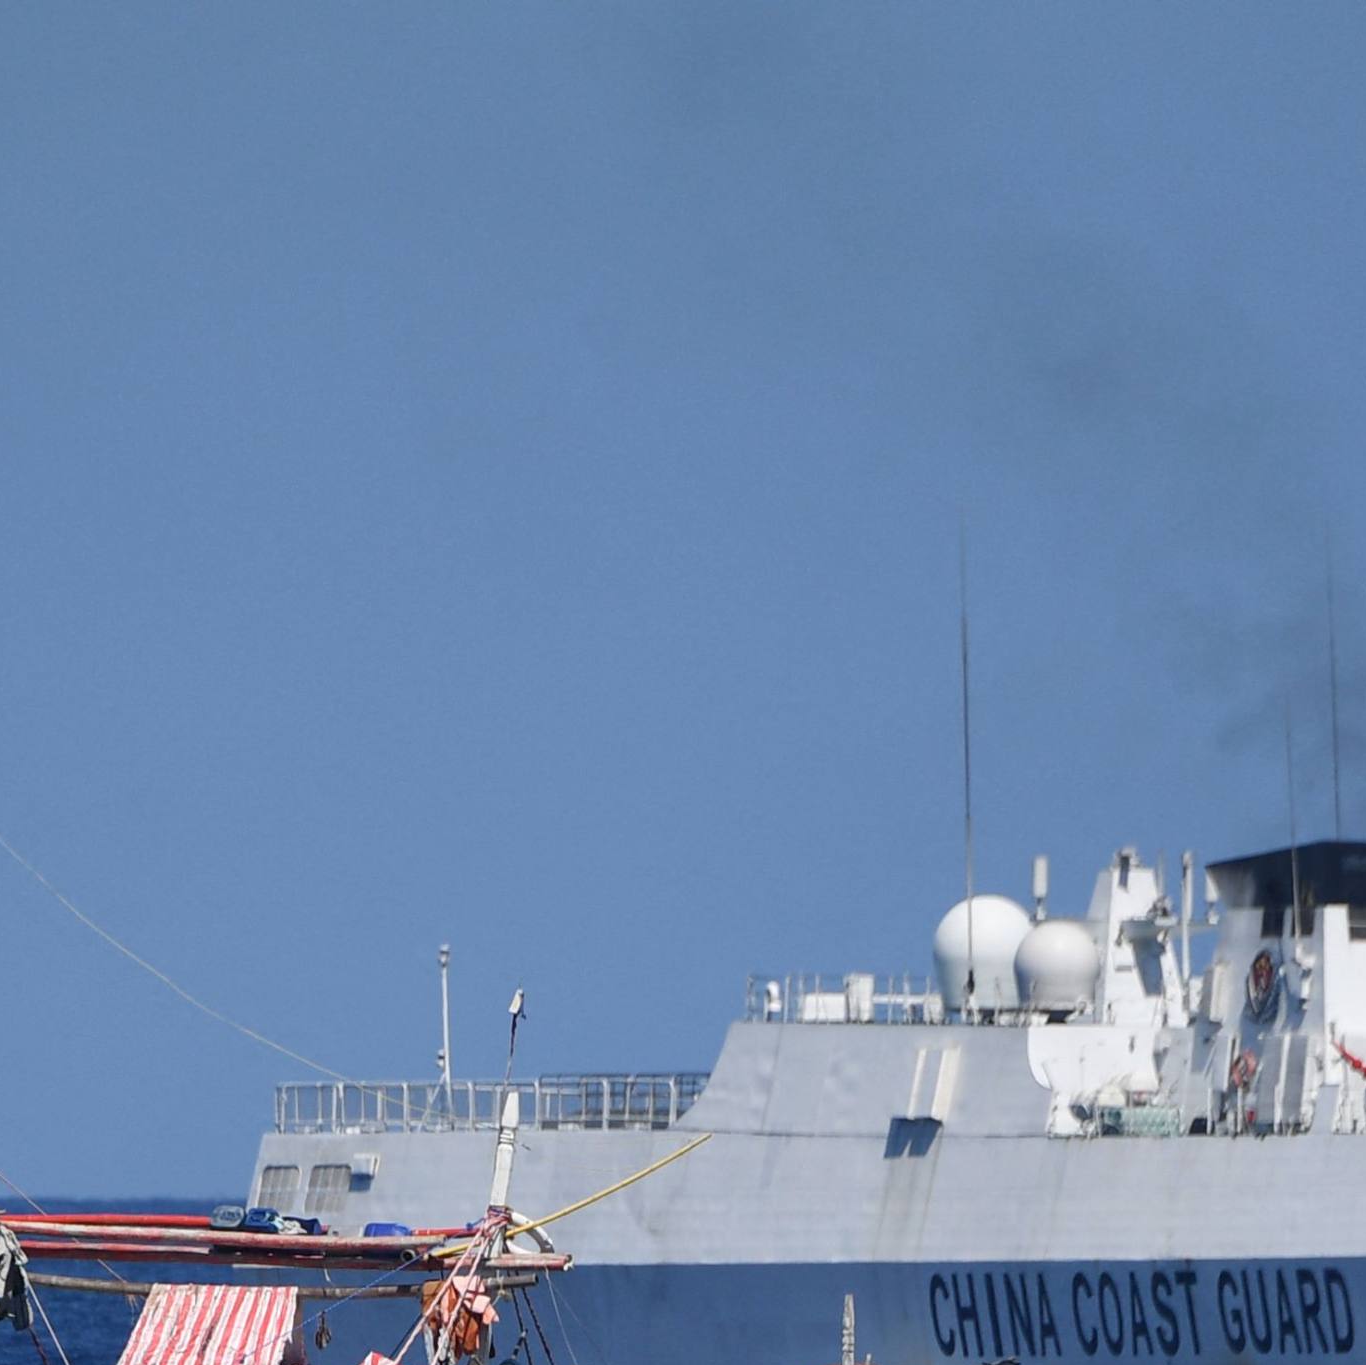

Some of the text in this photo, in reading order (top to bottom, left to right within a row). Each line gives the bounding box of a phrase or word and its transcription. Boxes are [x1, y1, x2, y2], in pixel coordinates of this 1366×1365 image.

[929, 1267, 1355, 1357] CHINA COAST GUARD
